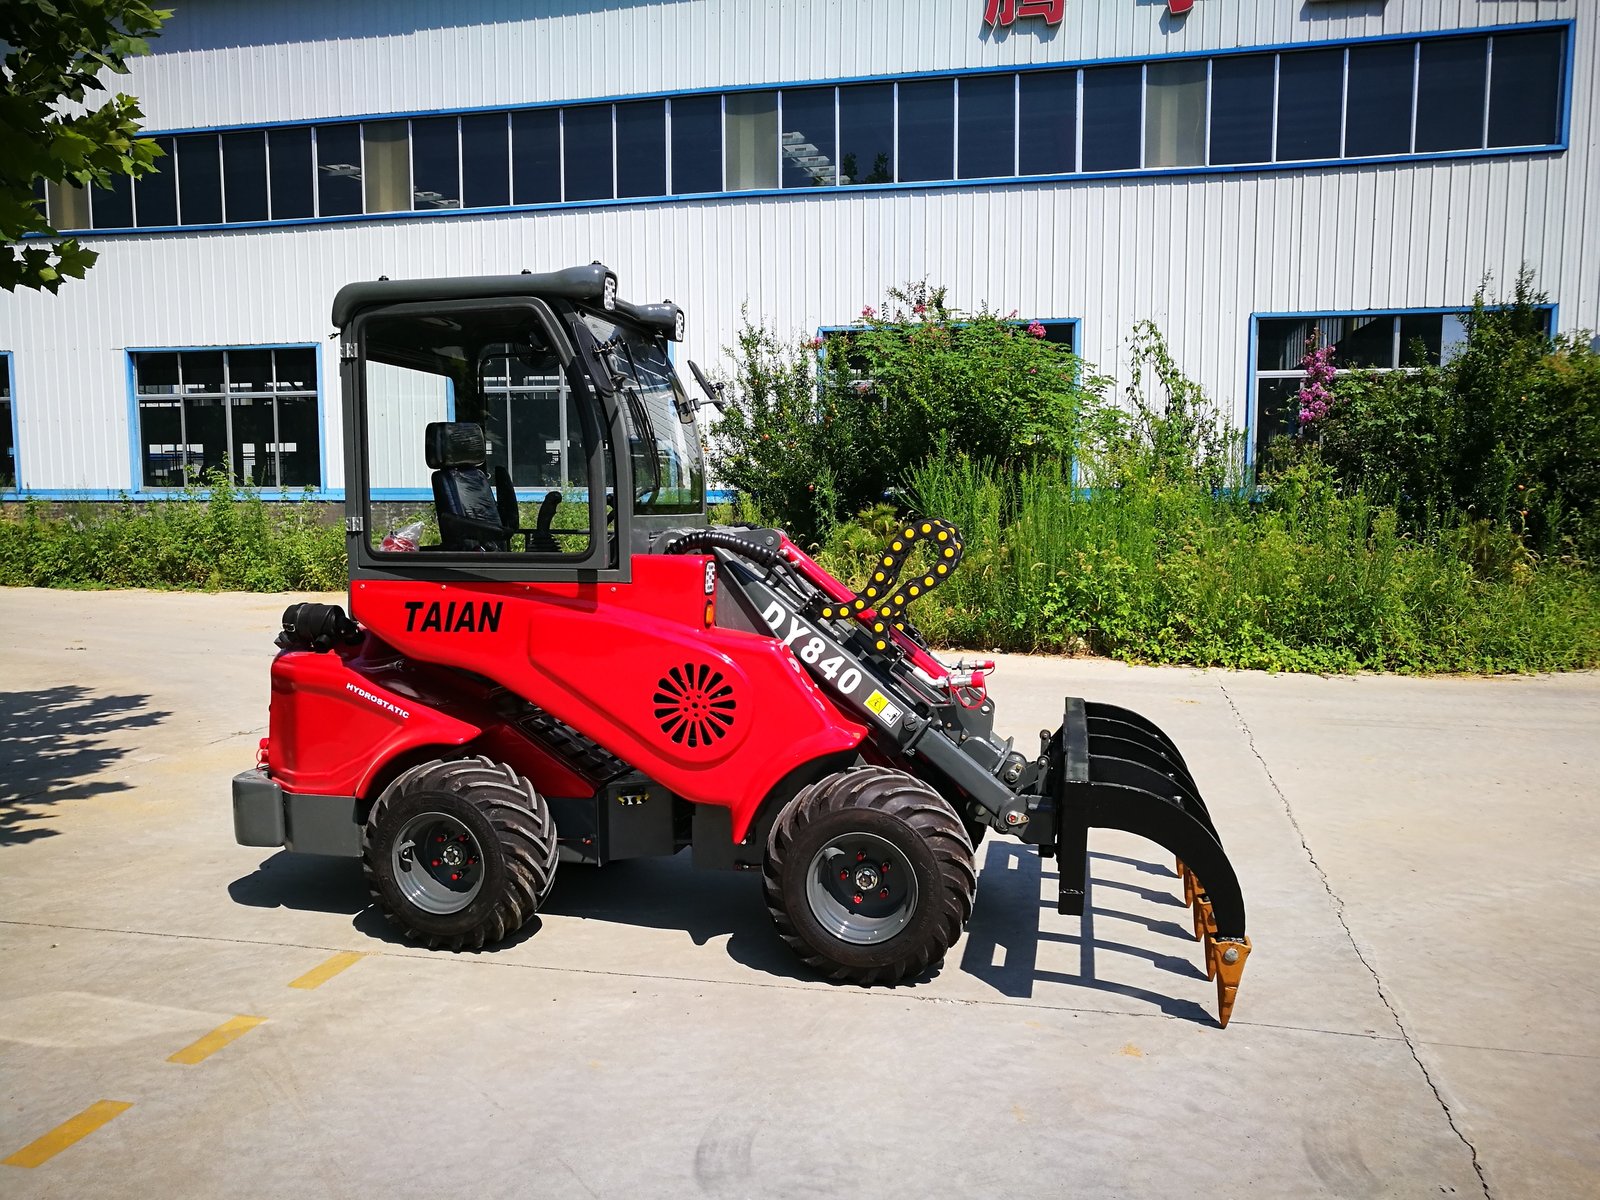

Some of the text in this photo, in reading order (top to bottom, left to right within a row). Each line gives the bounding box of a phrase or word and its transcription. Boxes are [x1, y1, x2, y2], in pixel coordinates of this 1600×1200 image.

[404, 602, 503, 632] TAIAN
[762, 600, 862, 694] DY840
[346, 682, 410, 719] HYDROSTATIC
